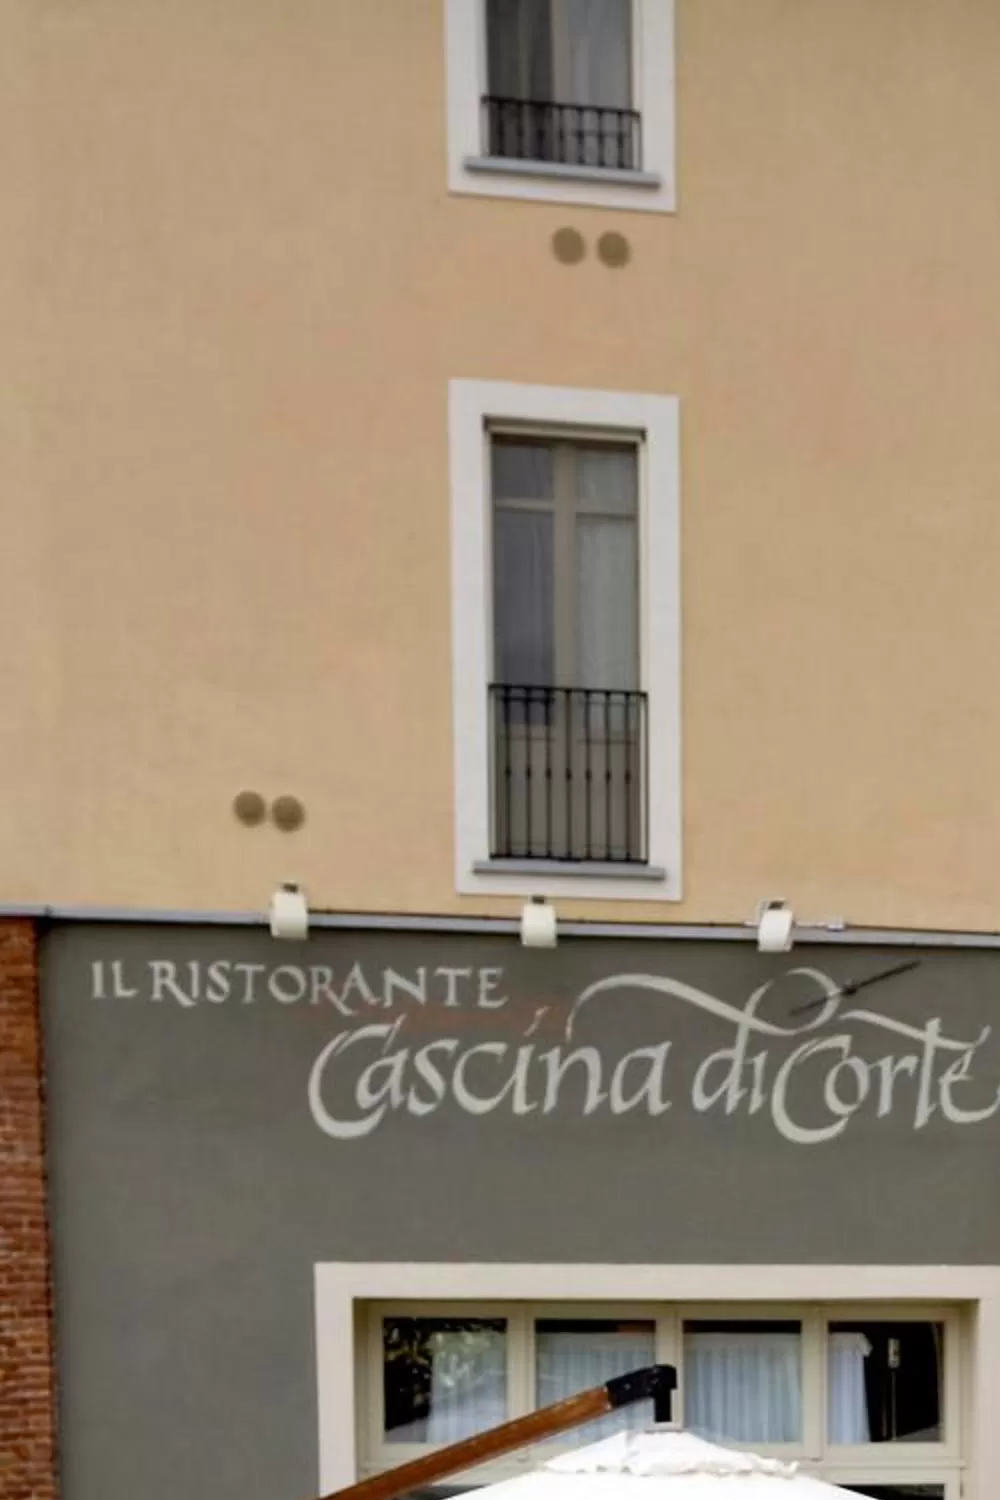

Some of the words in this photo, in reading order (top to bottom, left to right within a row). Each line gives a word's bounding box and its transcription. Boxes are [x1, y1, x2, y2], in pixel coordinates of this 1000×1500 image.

[91, 960, 138, 999] IL
[147, 960, 509, 1017] RISTORANTE
[307, 1004, 673, 1140] Cascina
[690, 976, 780, 1116] di
